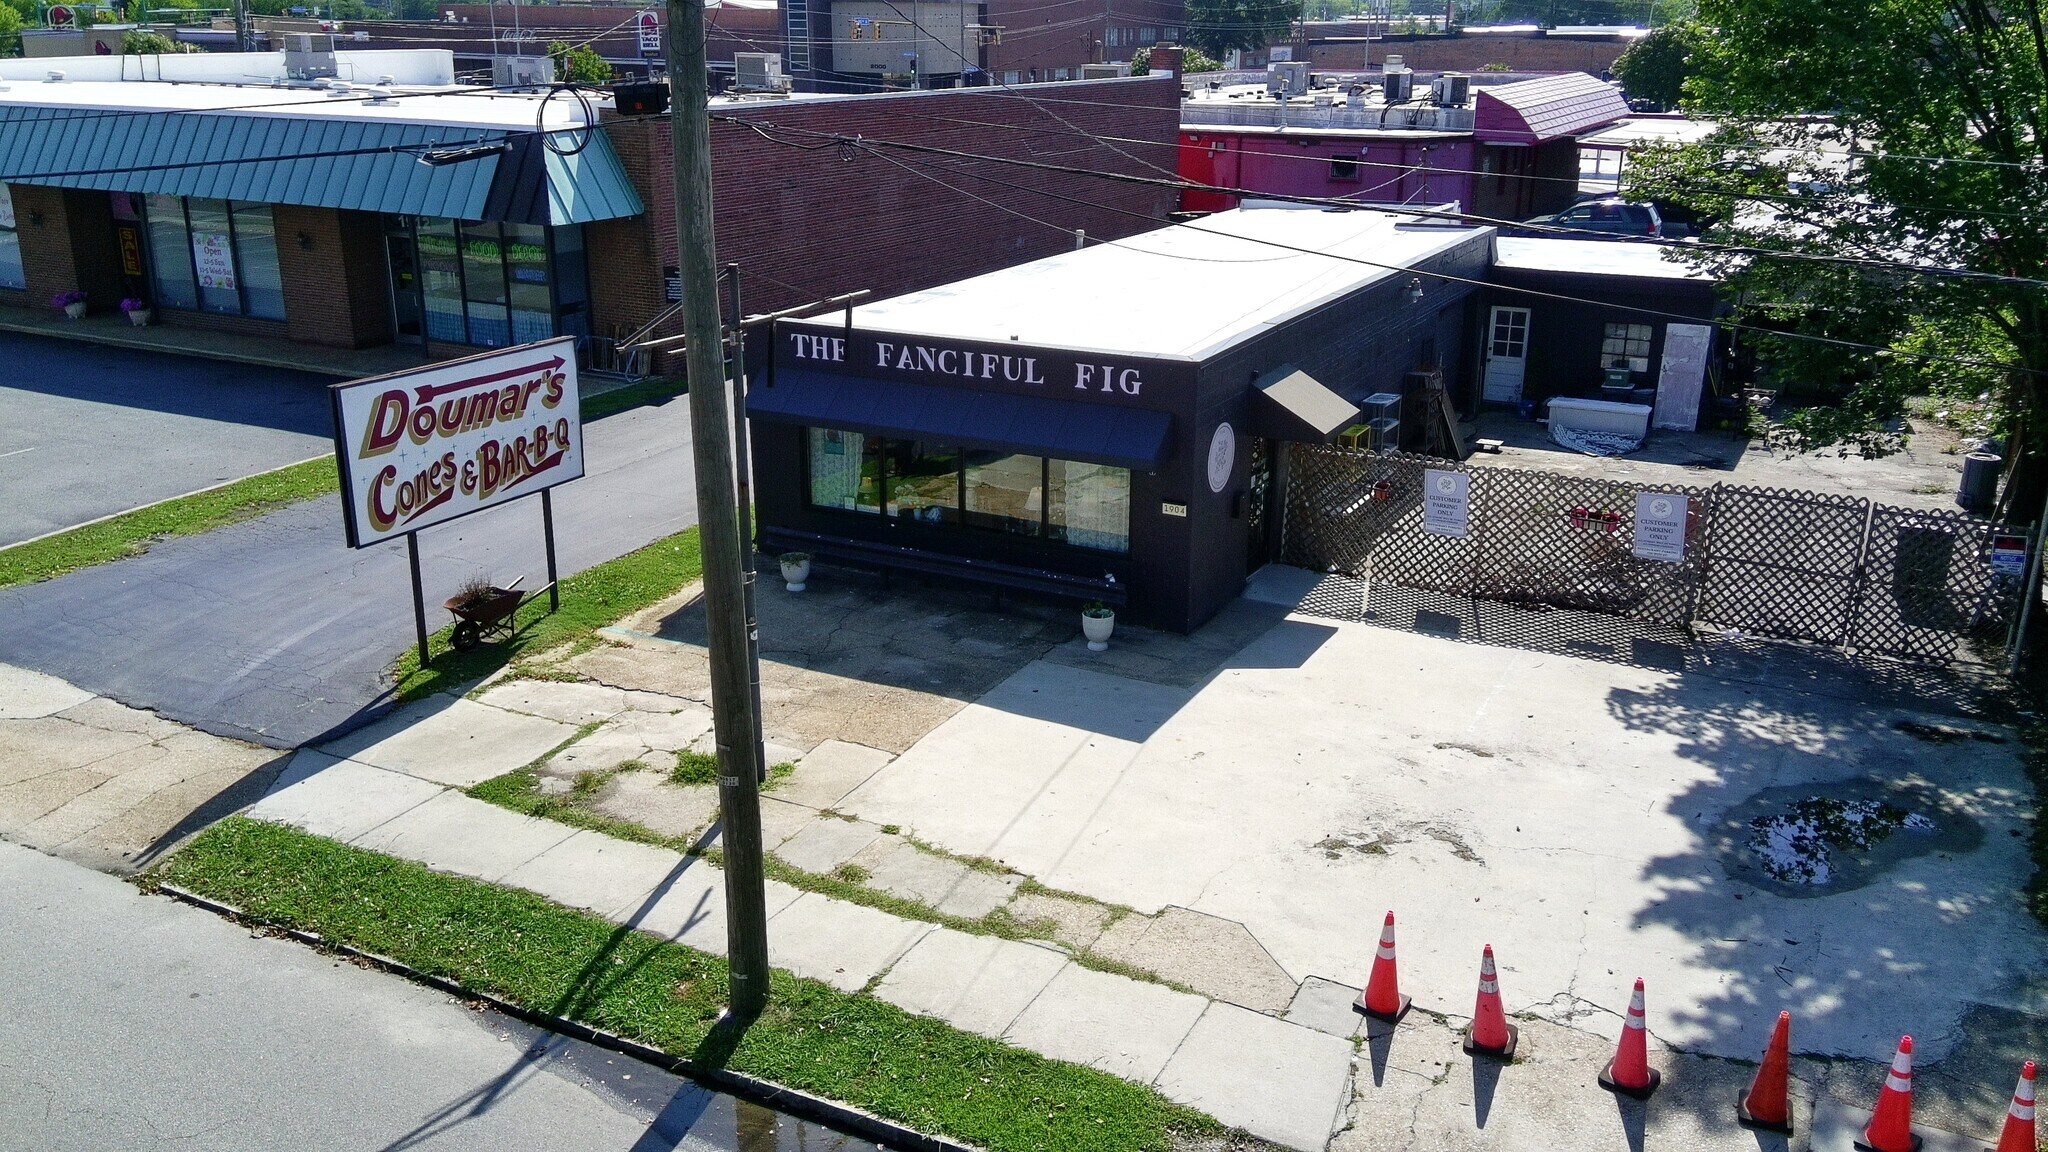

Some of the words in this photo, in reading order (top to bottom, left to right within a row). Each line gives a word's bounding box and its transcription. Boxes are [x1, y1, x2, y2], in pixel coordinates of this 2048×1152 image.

[122, 230, 137, 270] SALE
[204, 246, 222, 257] Open
[790, 333, 846, 362] THE
[876, 342, 1045, 384] FANCIFUL
[1075, 362, 1142, 395] FIG
[460, 460, 478, 496] &
[1429, 495, 1462, 504] CUSTOMER
[1164, 504, 1185, 514] 1904
[1432, 502, 1458, 510] PARKING
[1640, 518, 1679, 528] CUSTOMER
[1644, 526, 1674, 534] PARKING
